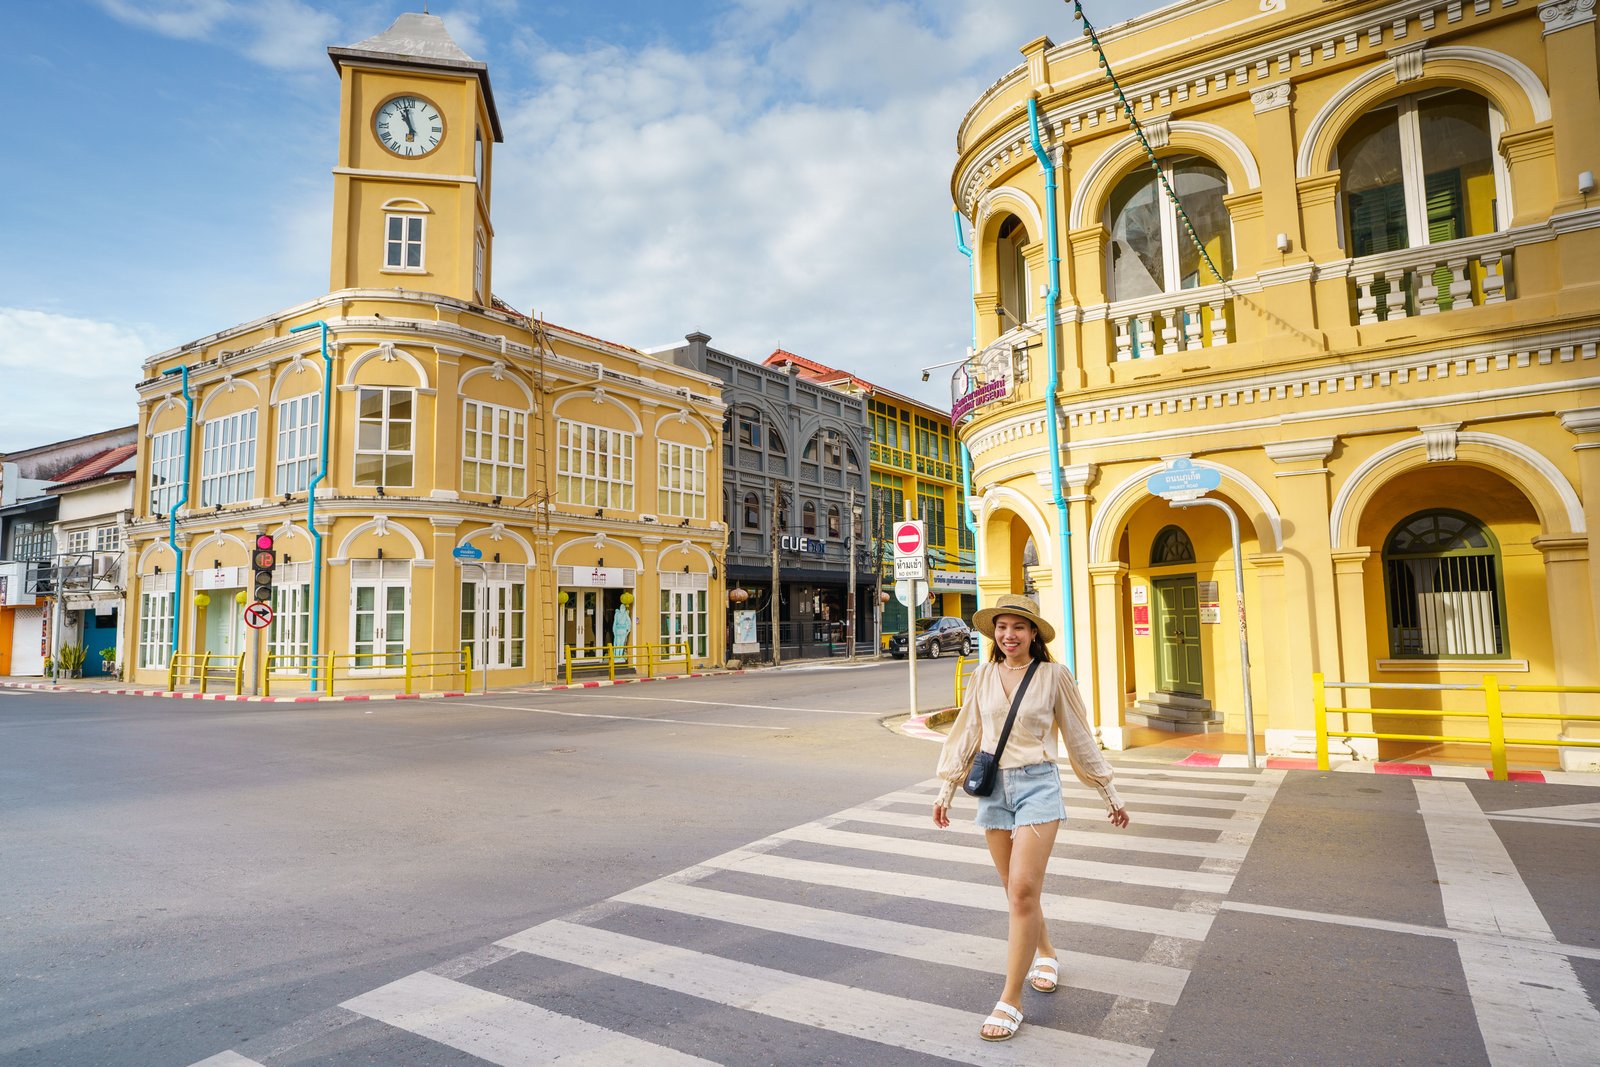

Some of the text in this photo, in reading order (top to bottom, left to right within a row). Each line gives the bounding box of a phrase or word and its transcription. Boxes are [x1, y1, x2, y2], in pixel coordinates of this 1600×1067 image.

[408, 100, 416, 108] XII
[382, 109, 393, 118] X
[381, 131, 392, 144] VIII
[391, 141, 401, 153] VII
[406, 147, 413, 156] VI
[421, 146, 427, 154] V
[976, 388, 1006, 407] MUSEUM
[1165, 471, 1201, 485] ถนนภูเก็ต
[260, 553, 273, 567] 12
[896, 558, 922, 570] ห้ามเข้า
